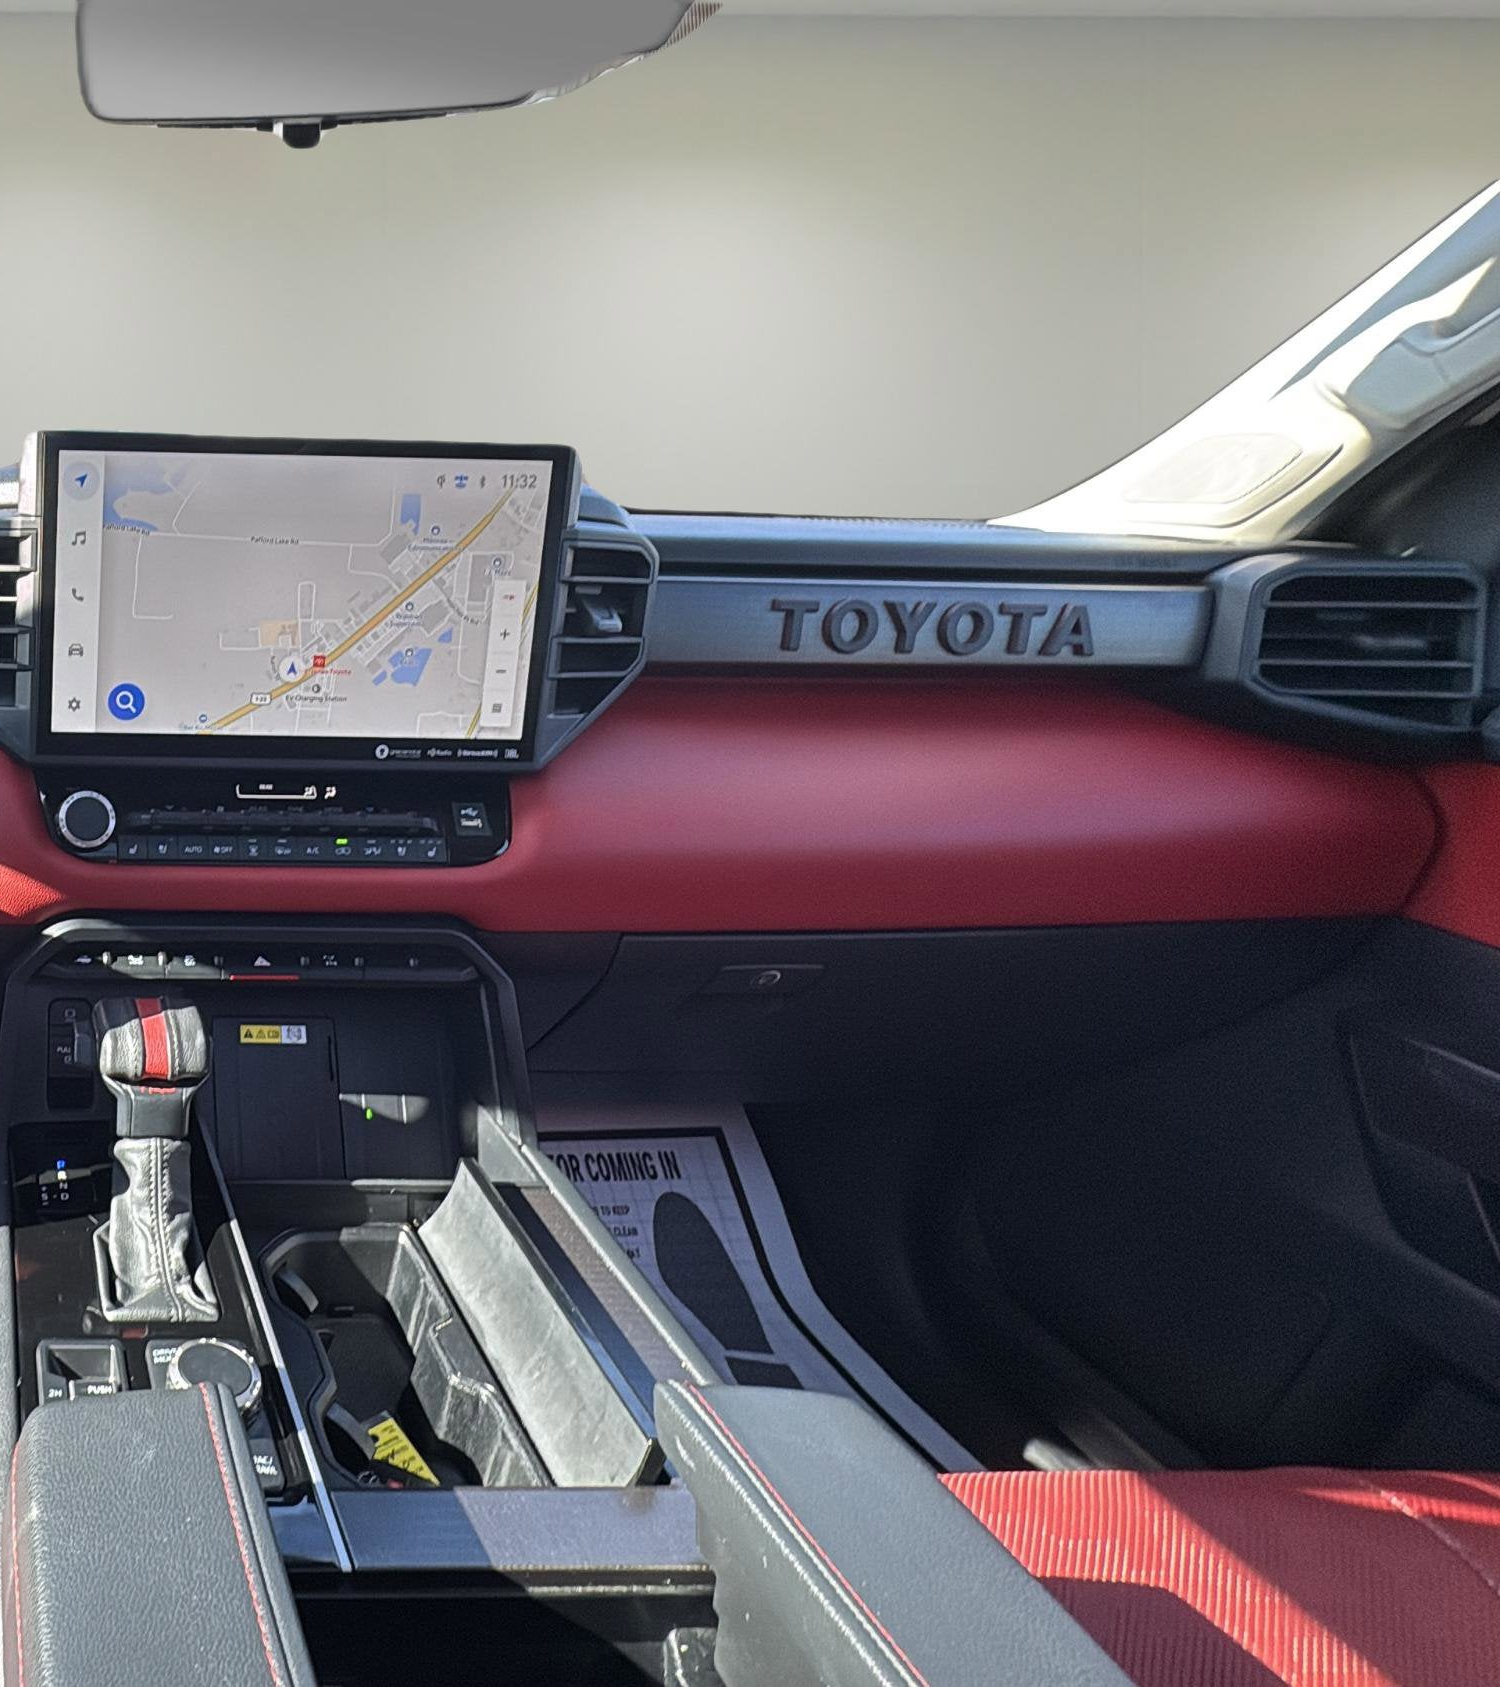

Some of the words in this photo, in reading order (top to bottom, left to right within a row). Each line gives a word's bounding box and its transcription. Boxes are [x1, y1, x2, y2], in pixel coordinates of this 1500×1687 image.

[501, 474, 538, 489] 11:32
[771, 599, 1093, 656] TOYOTA
[548, 1154, 584, 1182] OR
[585, 1152, 658, 1182] COMING
[659, 1151, 682, 1179] IN
[87, 1384, 112, 1395] PUSH
